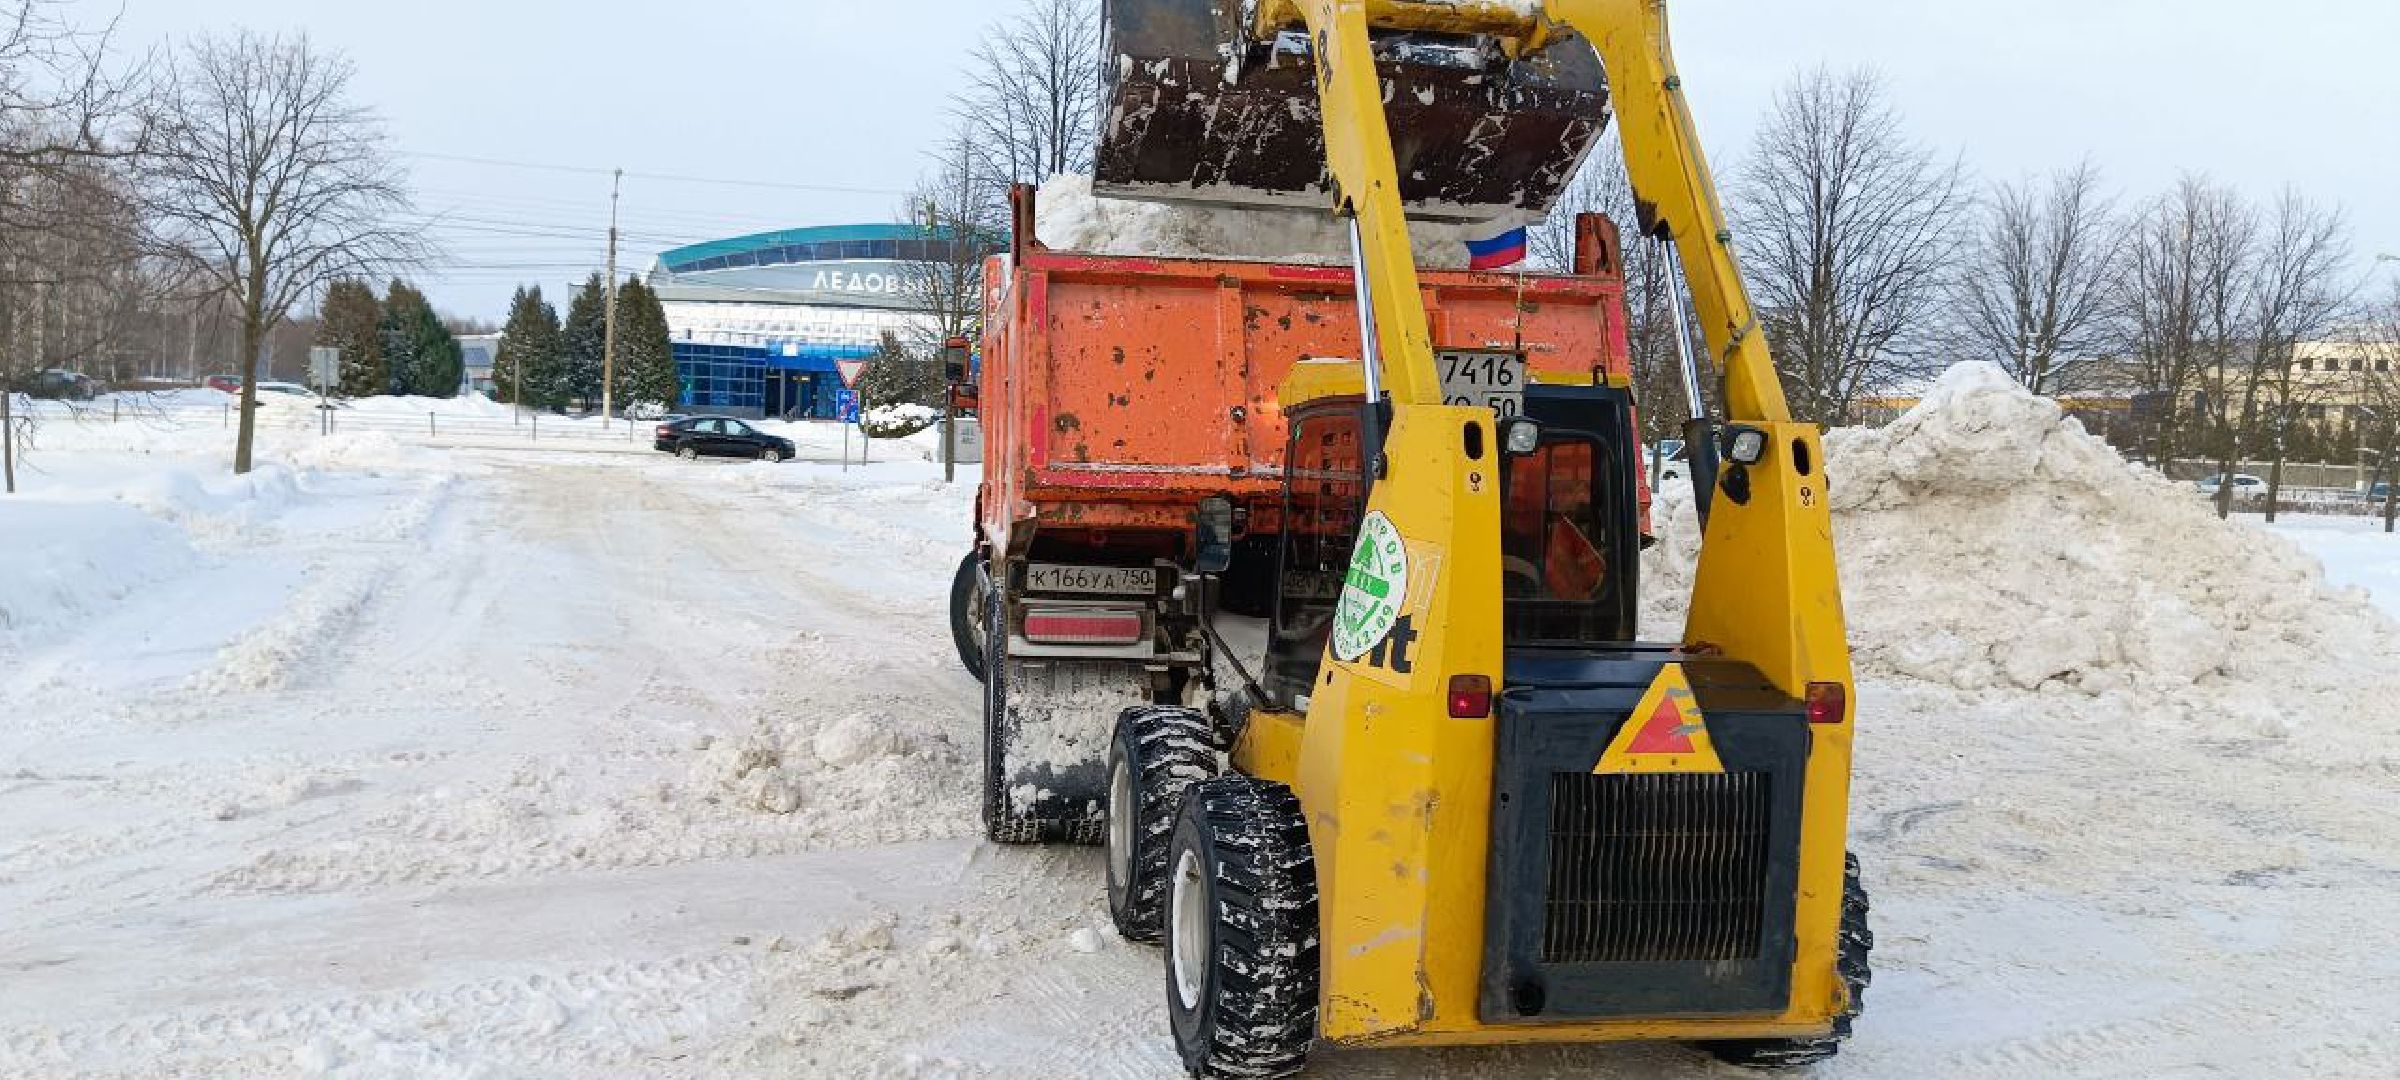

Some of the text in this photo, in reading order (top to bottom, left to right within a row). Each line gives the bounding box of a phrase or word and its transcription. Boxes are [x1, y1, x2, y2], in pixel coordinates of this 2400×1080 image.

[813, 269, 899, 294] ЛЕДОВ
[1442, 354, 1514, 387] 7416
[1487, 396, 1516, 419] 50
